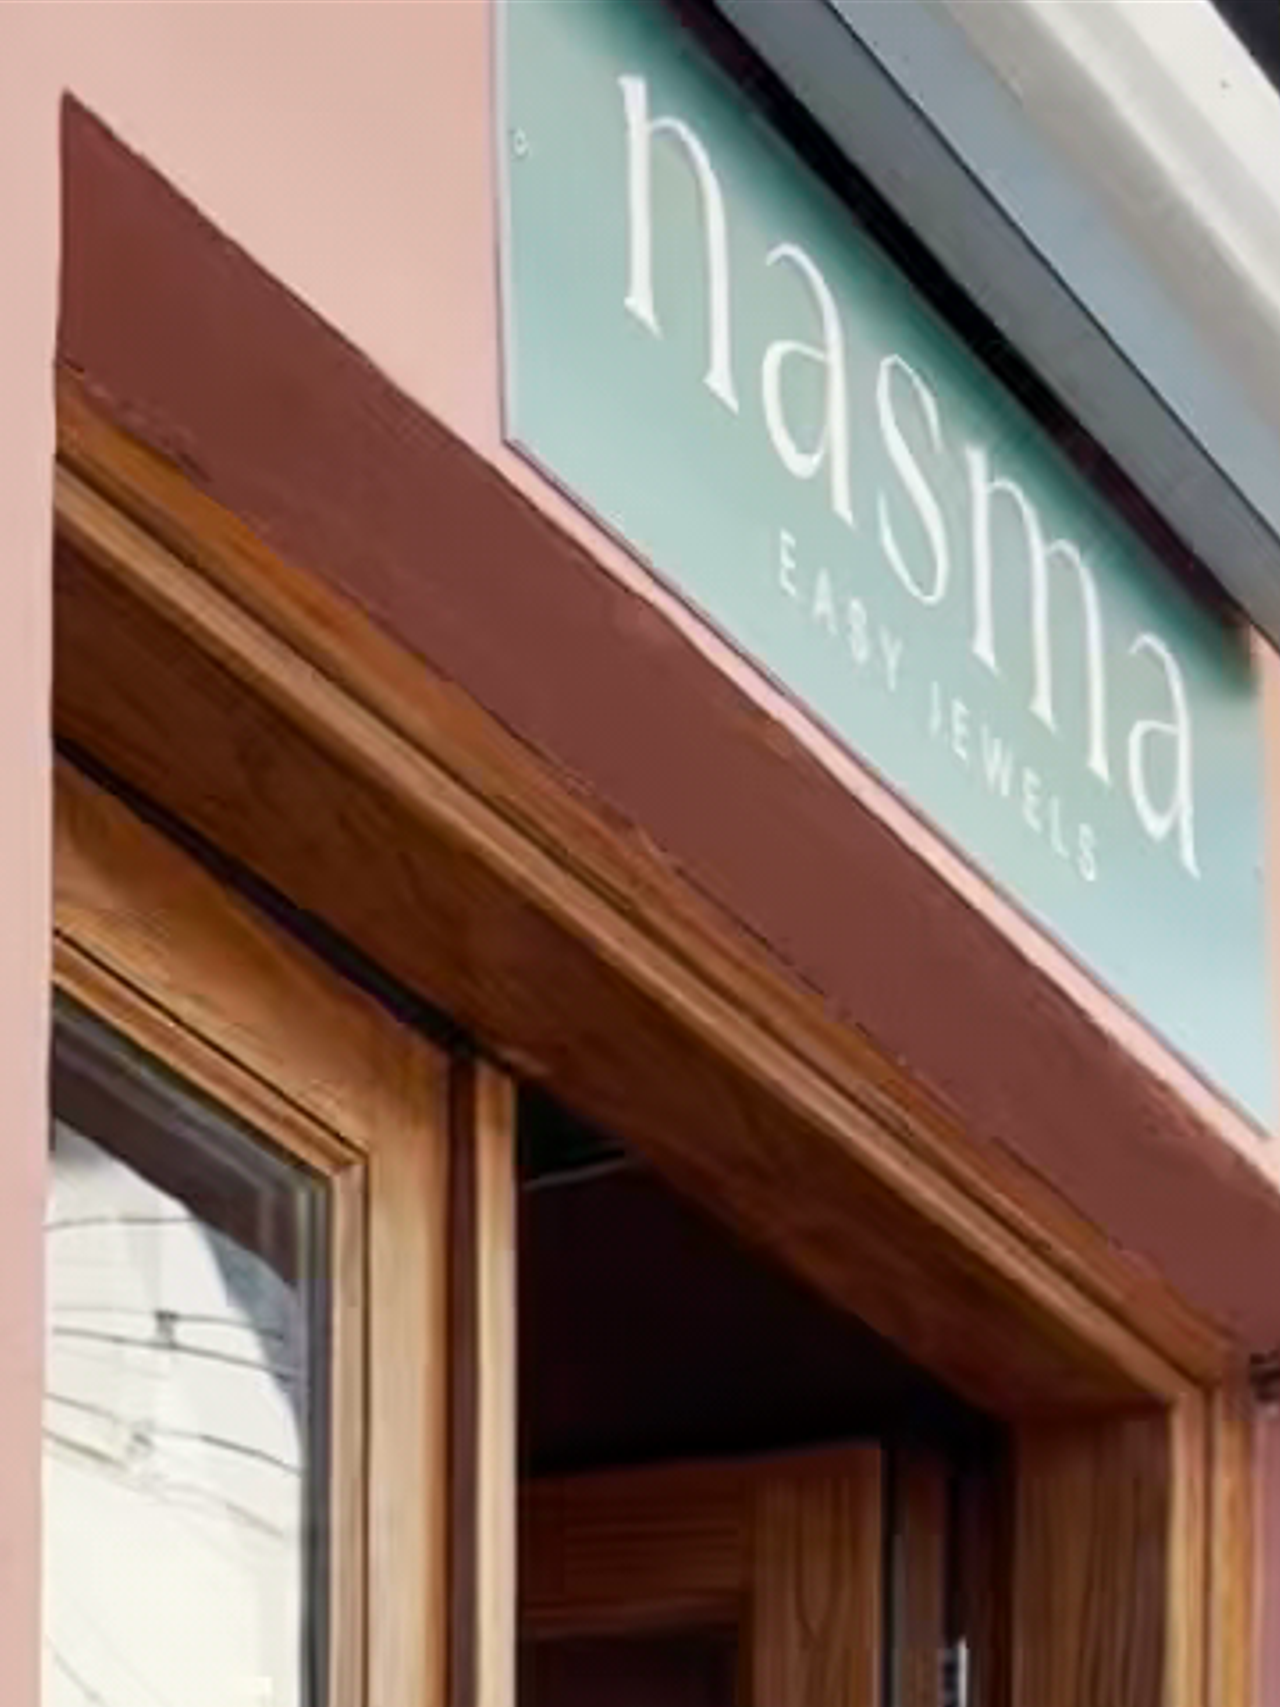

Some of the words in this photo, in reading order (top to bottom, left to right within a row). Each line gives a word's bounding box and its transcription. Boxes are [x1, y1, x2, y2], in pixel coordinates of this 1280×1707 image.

[617, 73, 1201, 880] nasma
[779, 526, 904, 692] EASY
[926, 679, 1098, 883] JEWELS
